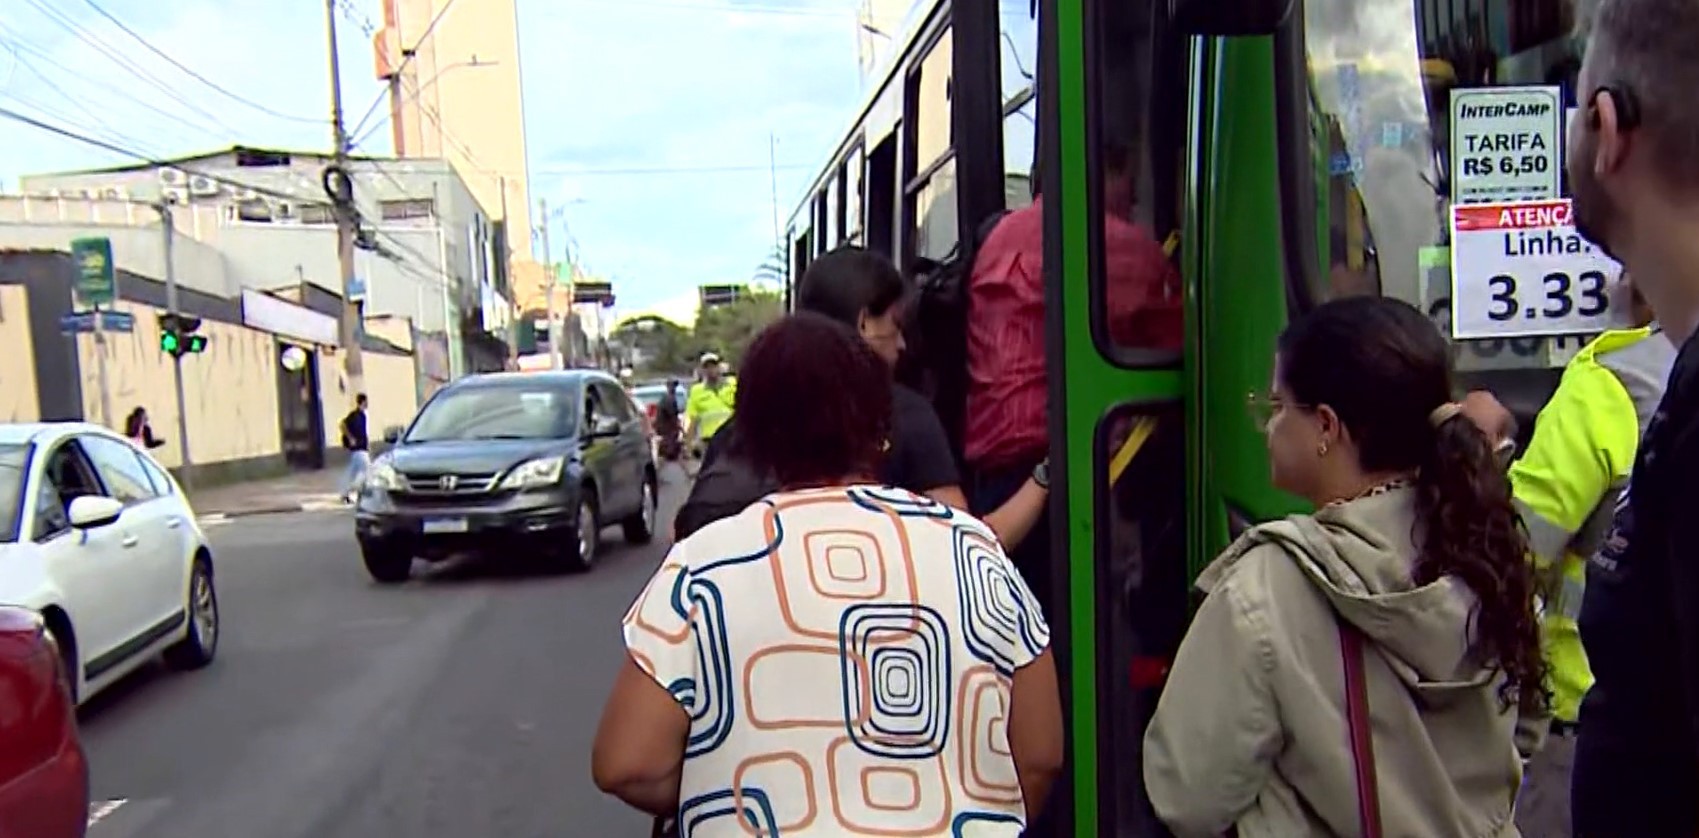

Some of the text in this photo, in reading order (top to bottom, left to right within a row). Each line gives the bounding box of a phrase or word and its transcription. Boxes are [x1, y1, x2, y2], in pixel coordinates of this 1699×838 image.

[1465, 133, 1545, 152] TARIFA
[1463, 155, 1548, 176] R$ 6,50
[1487, 270, 1609, 321] 3.33
